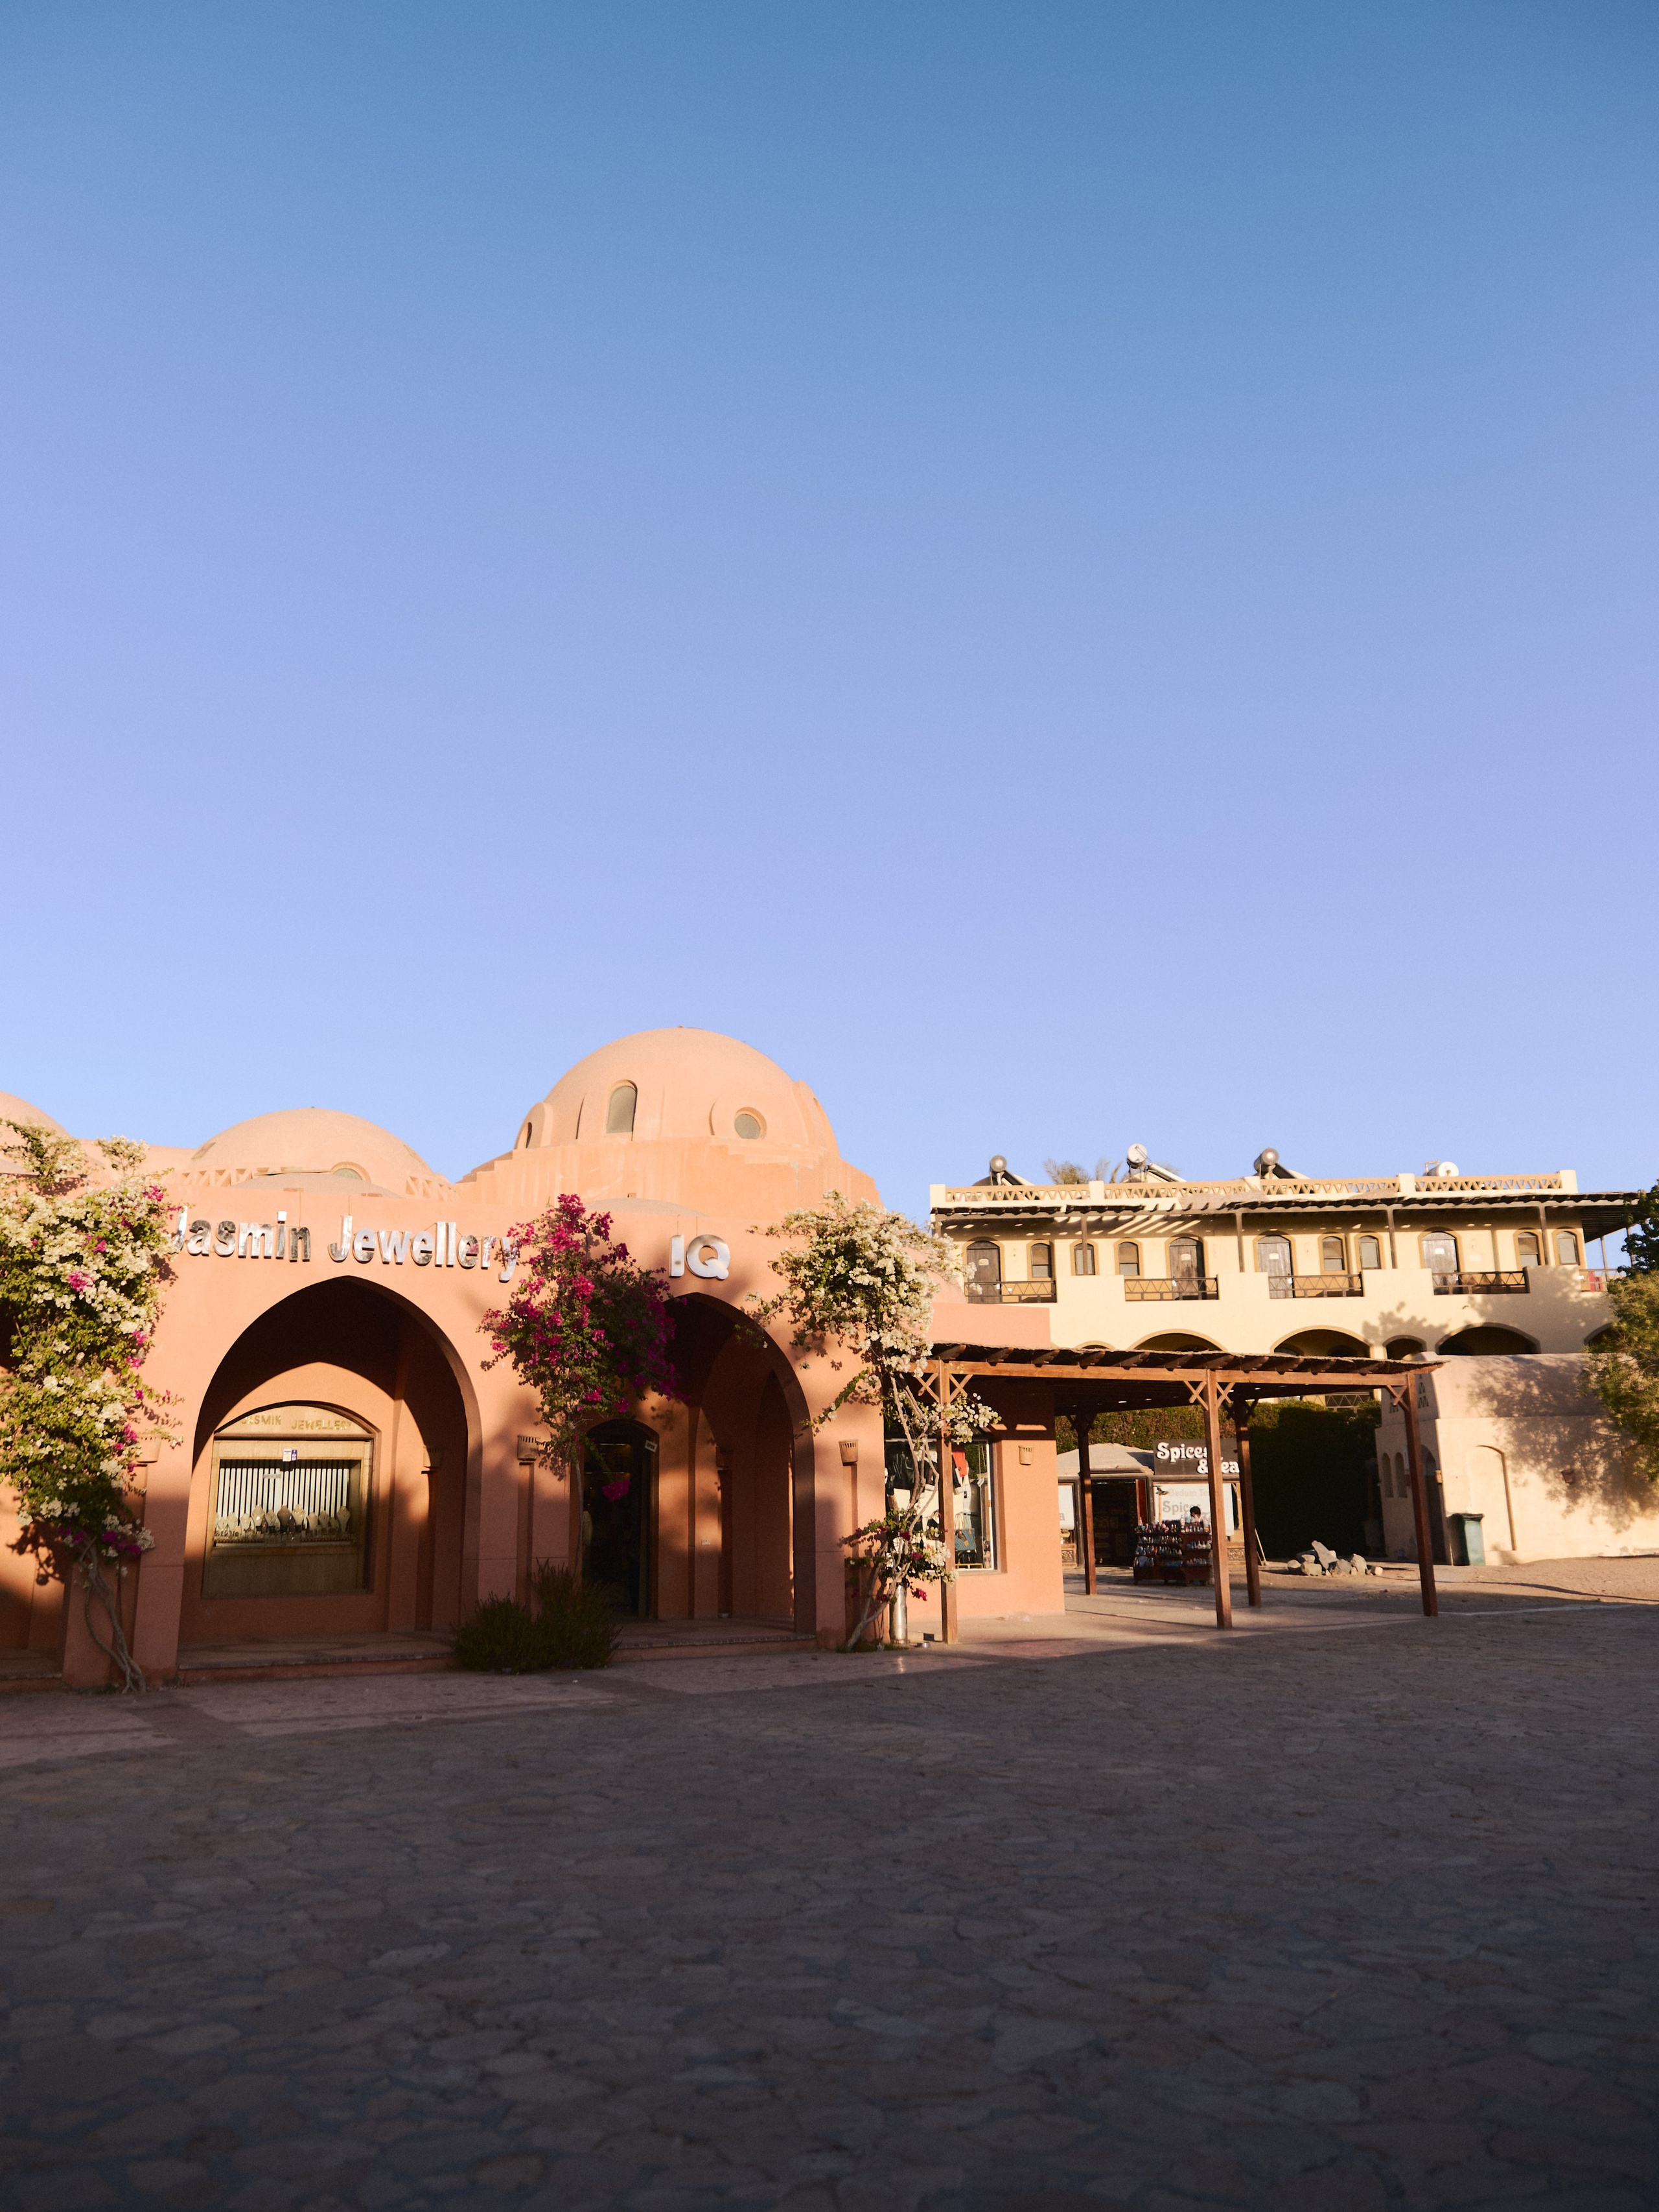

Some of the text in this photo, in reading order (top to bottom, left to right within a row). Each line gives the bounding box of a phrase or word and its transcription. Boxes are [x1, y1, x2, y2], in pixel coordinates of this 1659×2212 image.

[172, 1205, 519, 1283] Jasmin Jewellery
[669, 1234, 730, 1281] IQ
[1220, 1457, 1240, 1473] ea
